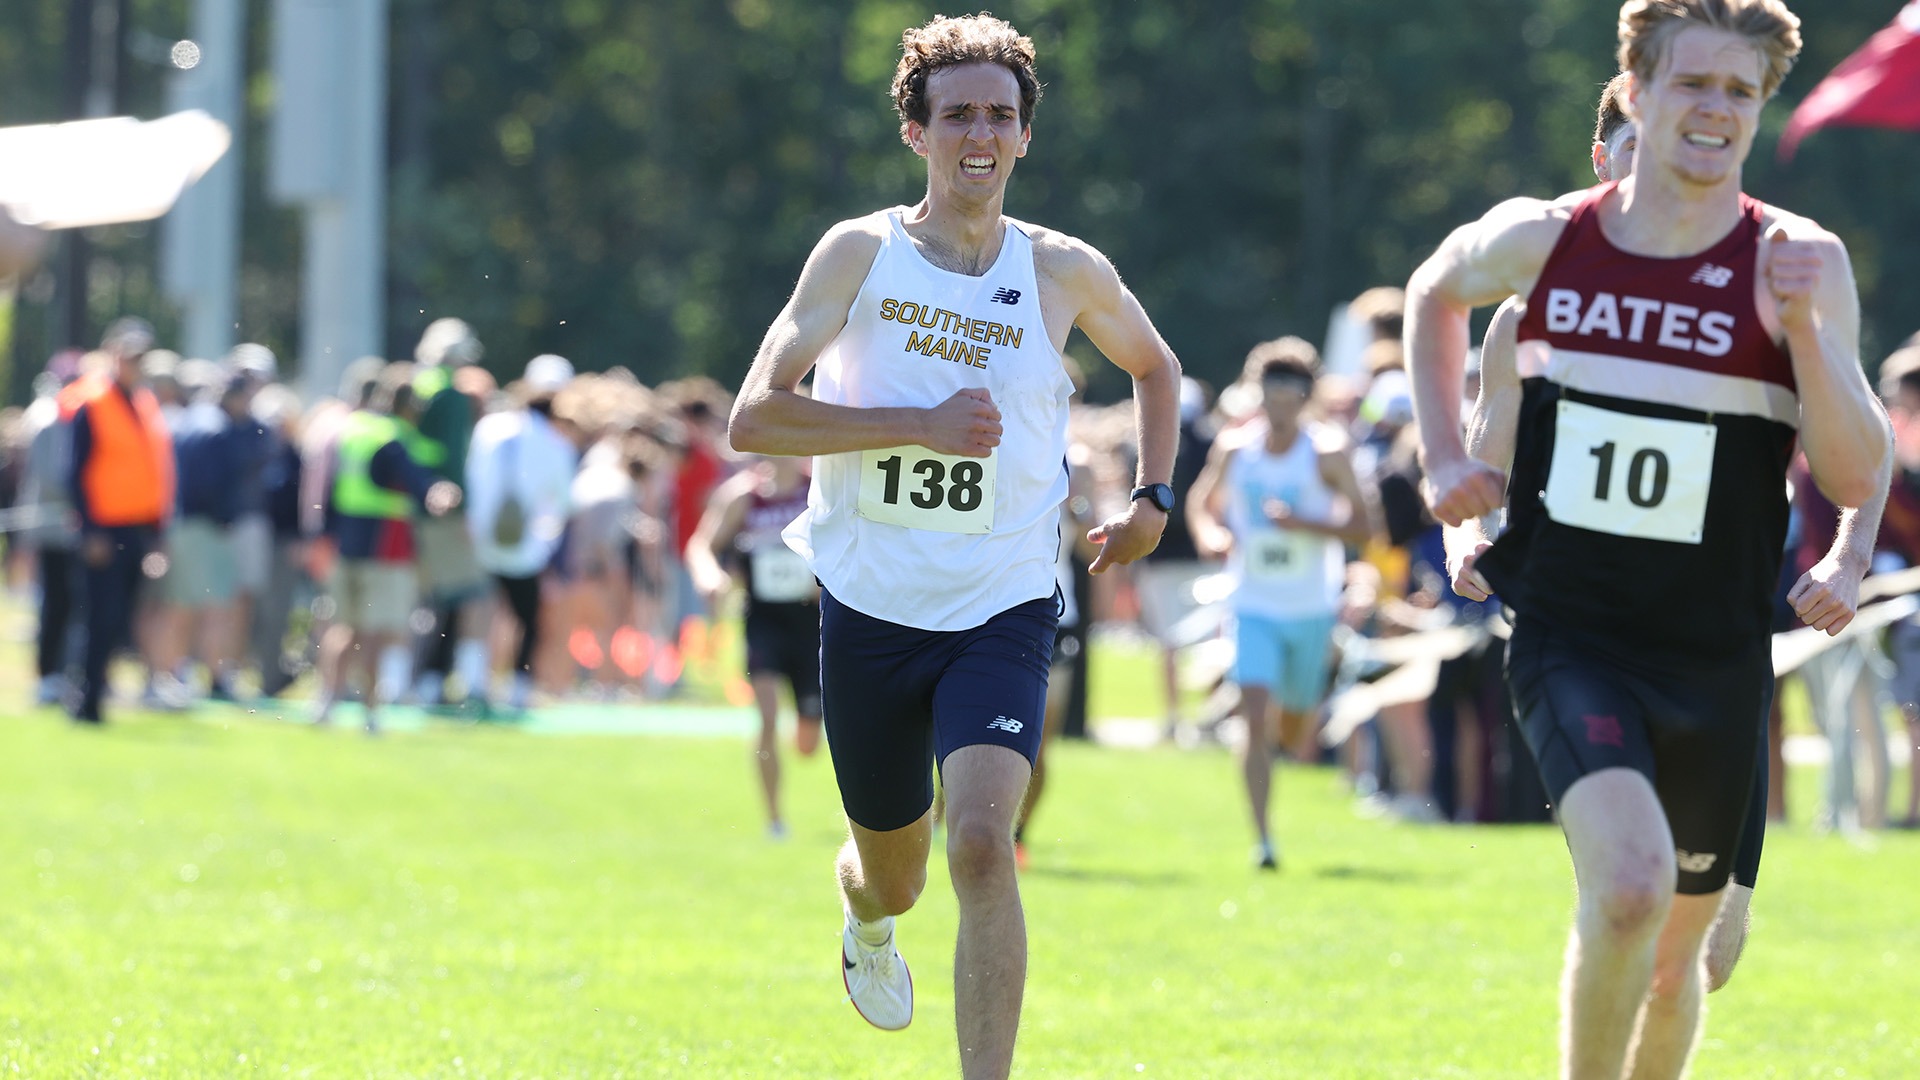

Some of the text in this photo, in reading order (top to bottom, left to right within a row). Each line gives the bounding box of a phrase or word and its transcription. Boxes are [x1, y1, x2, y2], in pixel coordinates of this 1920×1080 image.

[880, 298, 1023, 349] SOUTHERN
[905, 331, 991, 369] MAINE
[1546, 288, 1735, 357] BATES
[877, 455, 984, 512] 138
[1589, 440, 1670, 509] 10
